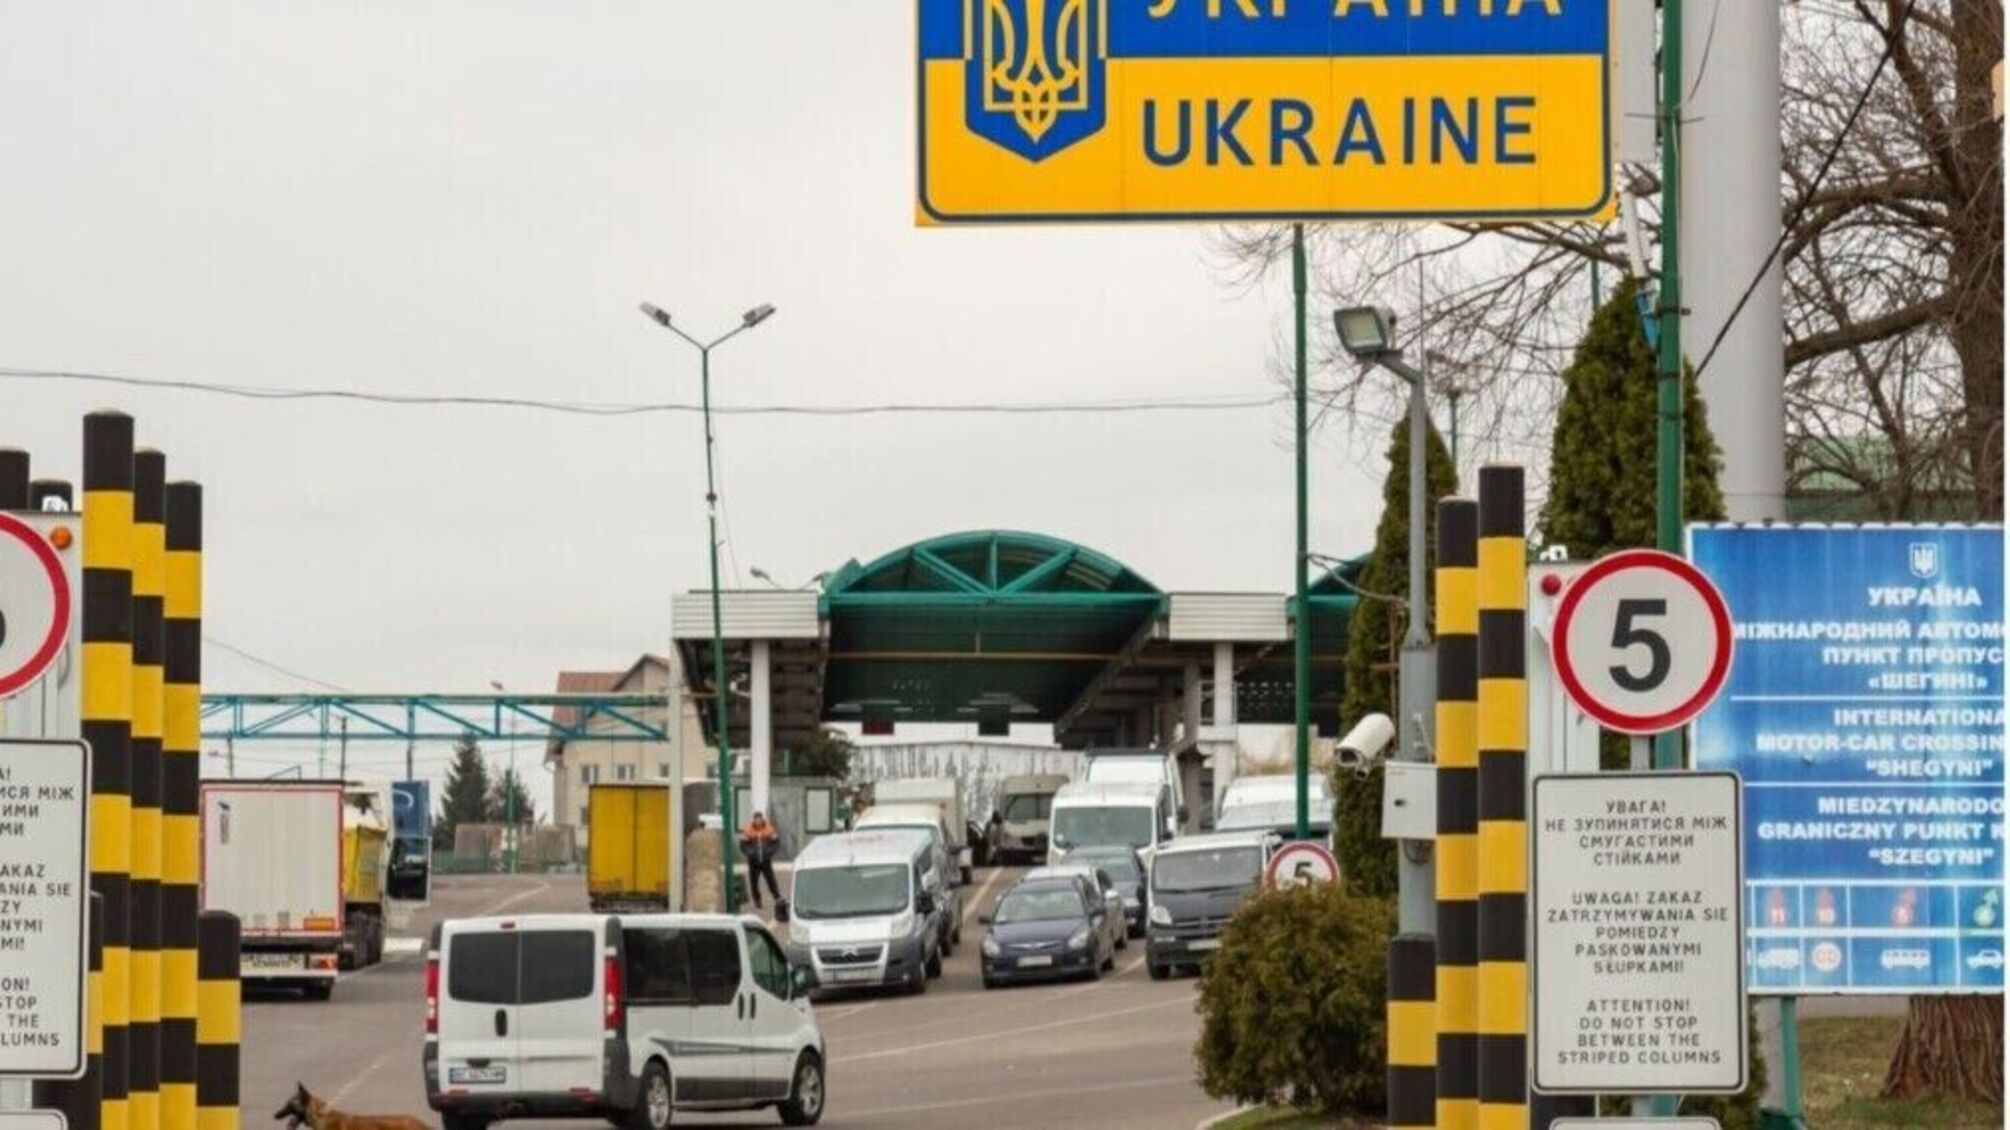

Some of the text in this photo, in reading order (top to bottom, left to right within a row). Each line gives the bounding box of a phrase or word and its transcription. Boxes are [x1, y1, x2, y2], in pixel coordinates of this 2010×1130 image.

[1143, 96, 1537, 168] UKRAINE
[1868, 583, 1982, 607] УКРАЇНА
[1918, 621, 2004, 640] АВТОМ
[1609, 598, 1671, 693] 5
[1822, 647, 1900, 665] ПУНКТ
[1756, 733, 1895, 752] MOTOR-CAR
[37, 786, 74, 800] МІЖ
[1606, 799, 1667, 814] УВАГА!
[1545, 816, 1728, 832] НЕ ЗУПИНЯТИСЯ МІЖ
[1757, 822, 1897, 840] GRANICZNY
[1903, 822, 1985, 840] PUNKT
[1579, 835, 1695, 848] СМУГАСТИМИ
[1593, 851, 1681, 866] СТІЙКАМИ
[1572, 891, 1703, 905] UWAGA! ZAKAZ
[1547, 909, 1696, 923] ZATRZYMYWANIA
[1595, 926, 1681, 940] POMIEDZY
[1575, 942, 1703, 957] PASKOWANYMI
[1586, 1000, 1691, 1013] ATTENTION!
[8, 1014, 39, 1028] THE
[1579, 1016, 1698, 1030] DO NOT STOP
[1577, 1033, 1701, 1047] BETWEEN THE
[1557, 1050, 1722, 1065] STRIPED COLUMNS
